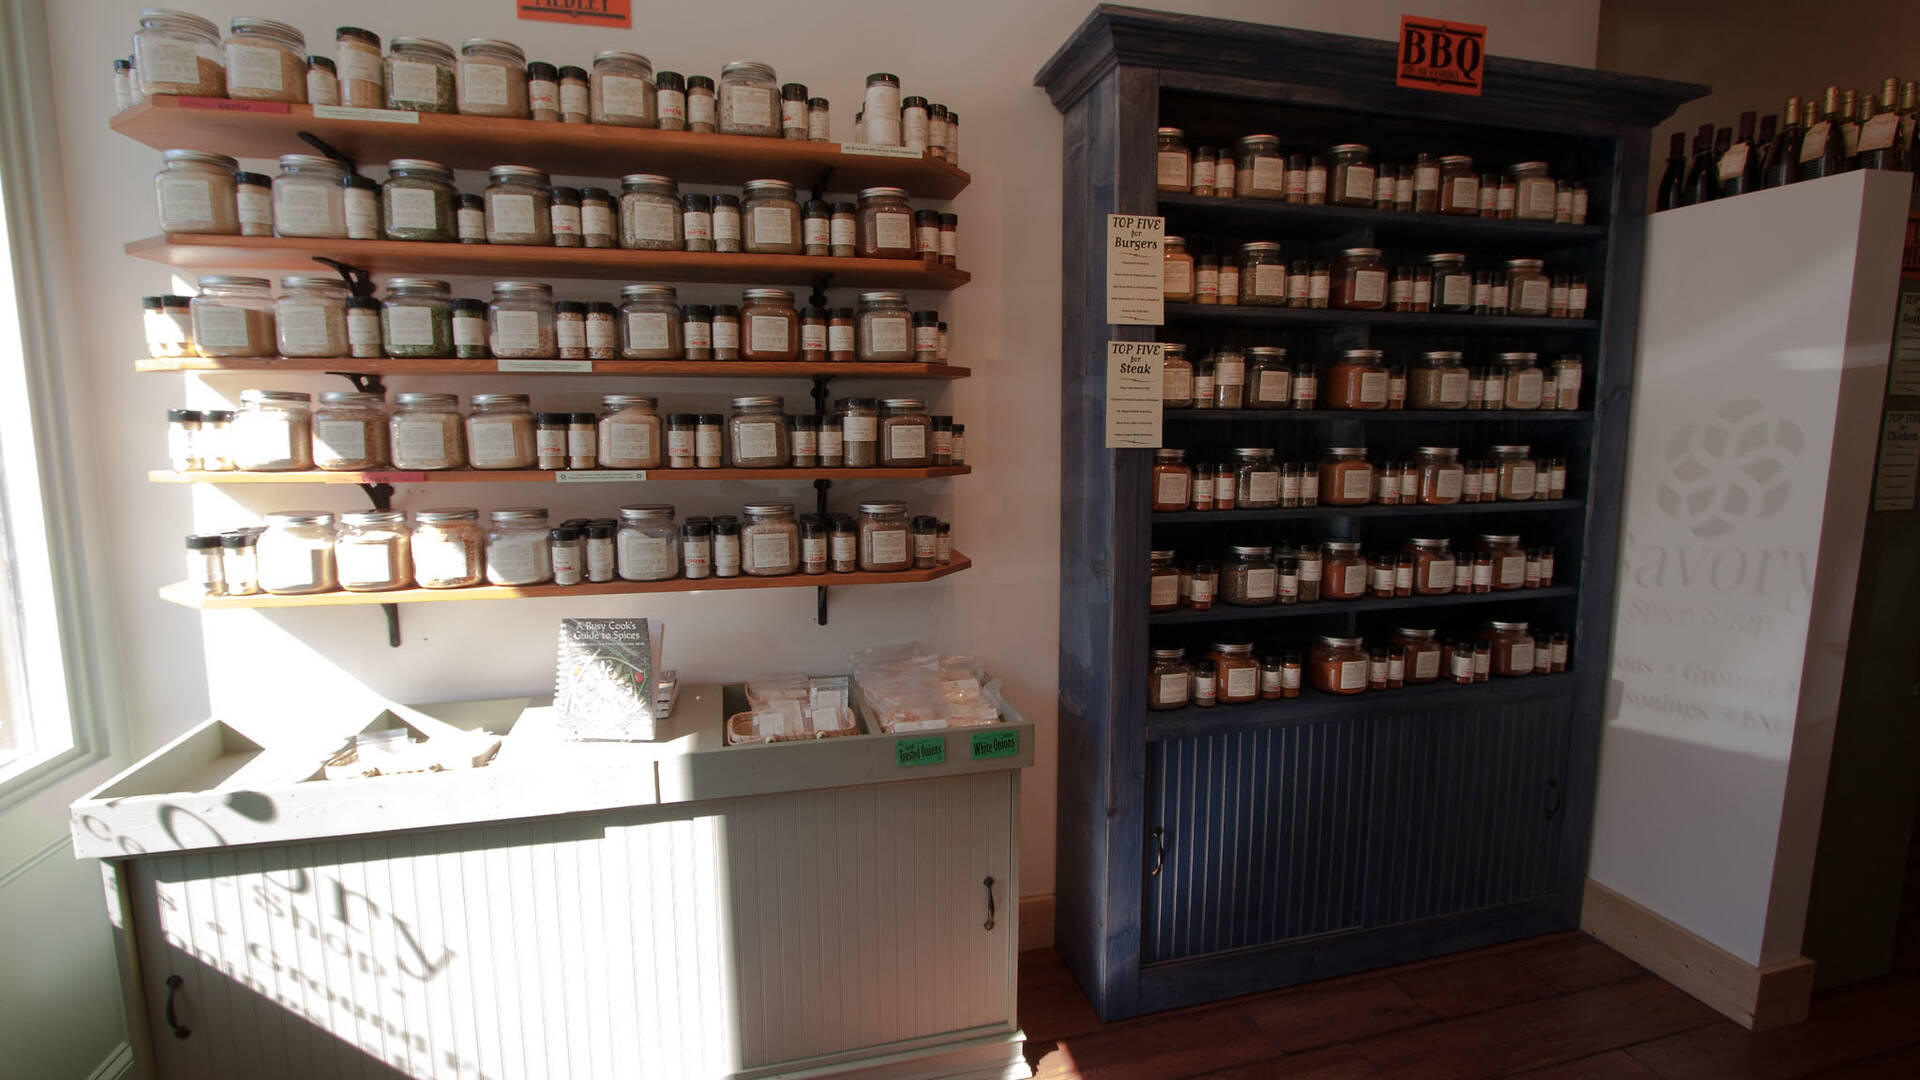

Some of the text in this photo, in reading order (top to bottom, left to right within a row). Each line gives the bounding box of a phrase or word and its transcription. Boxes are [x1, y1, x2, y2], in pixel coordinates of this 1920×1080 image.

[1402, 29, 1481, 81] BBQ
[1113, 216, 1161, 230] TOP FIVE
[1115, 237, 1158, 251] Burgers
[1113, 343, 1161, 356] TOP FIVE
[1120, 363, 1151, 375] Steak
[576, 621, 637, 632] A Busy Cook's
[573, 631, 641, 641] Guide to Spices
[974, 737, 1015, 756] White Onions
